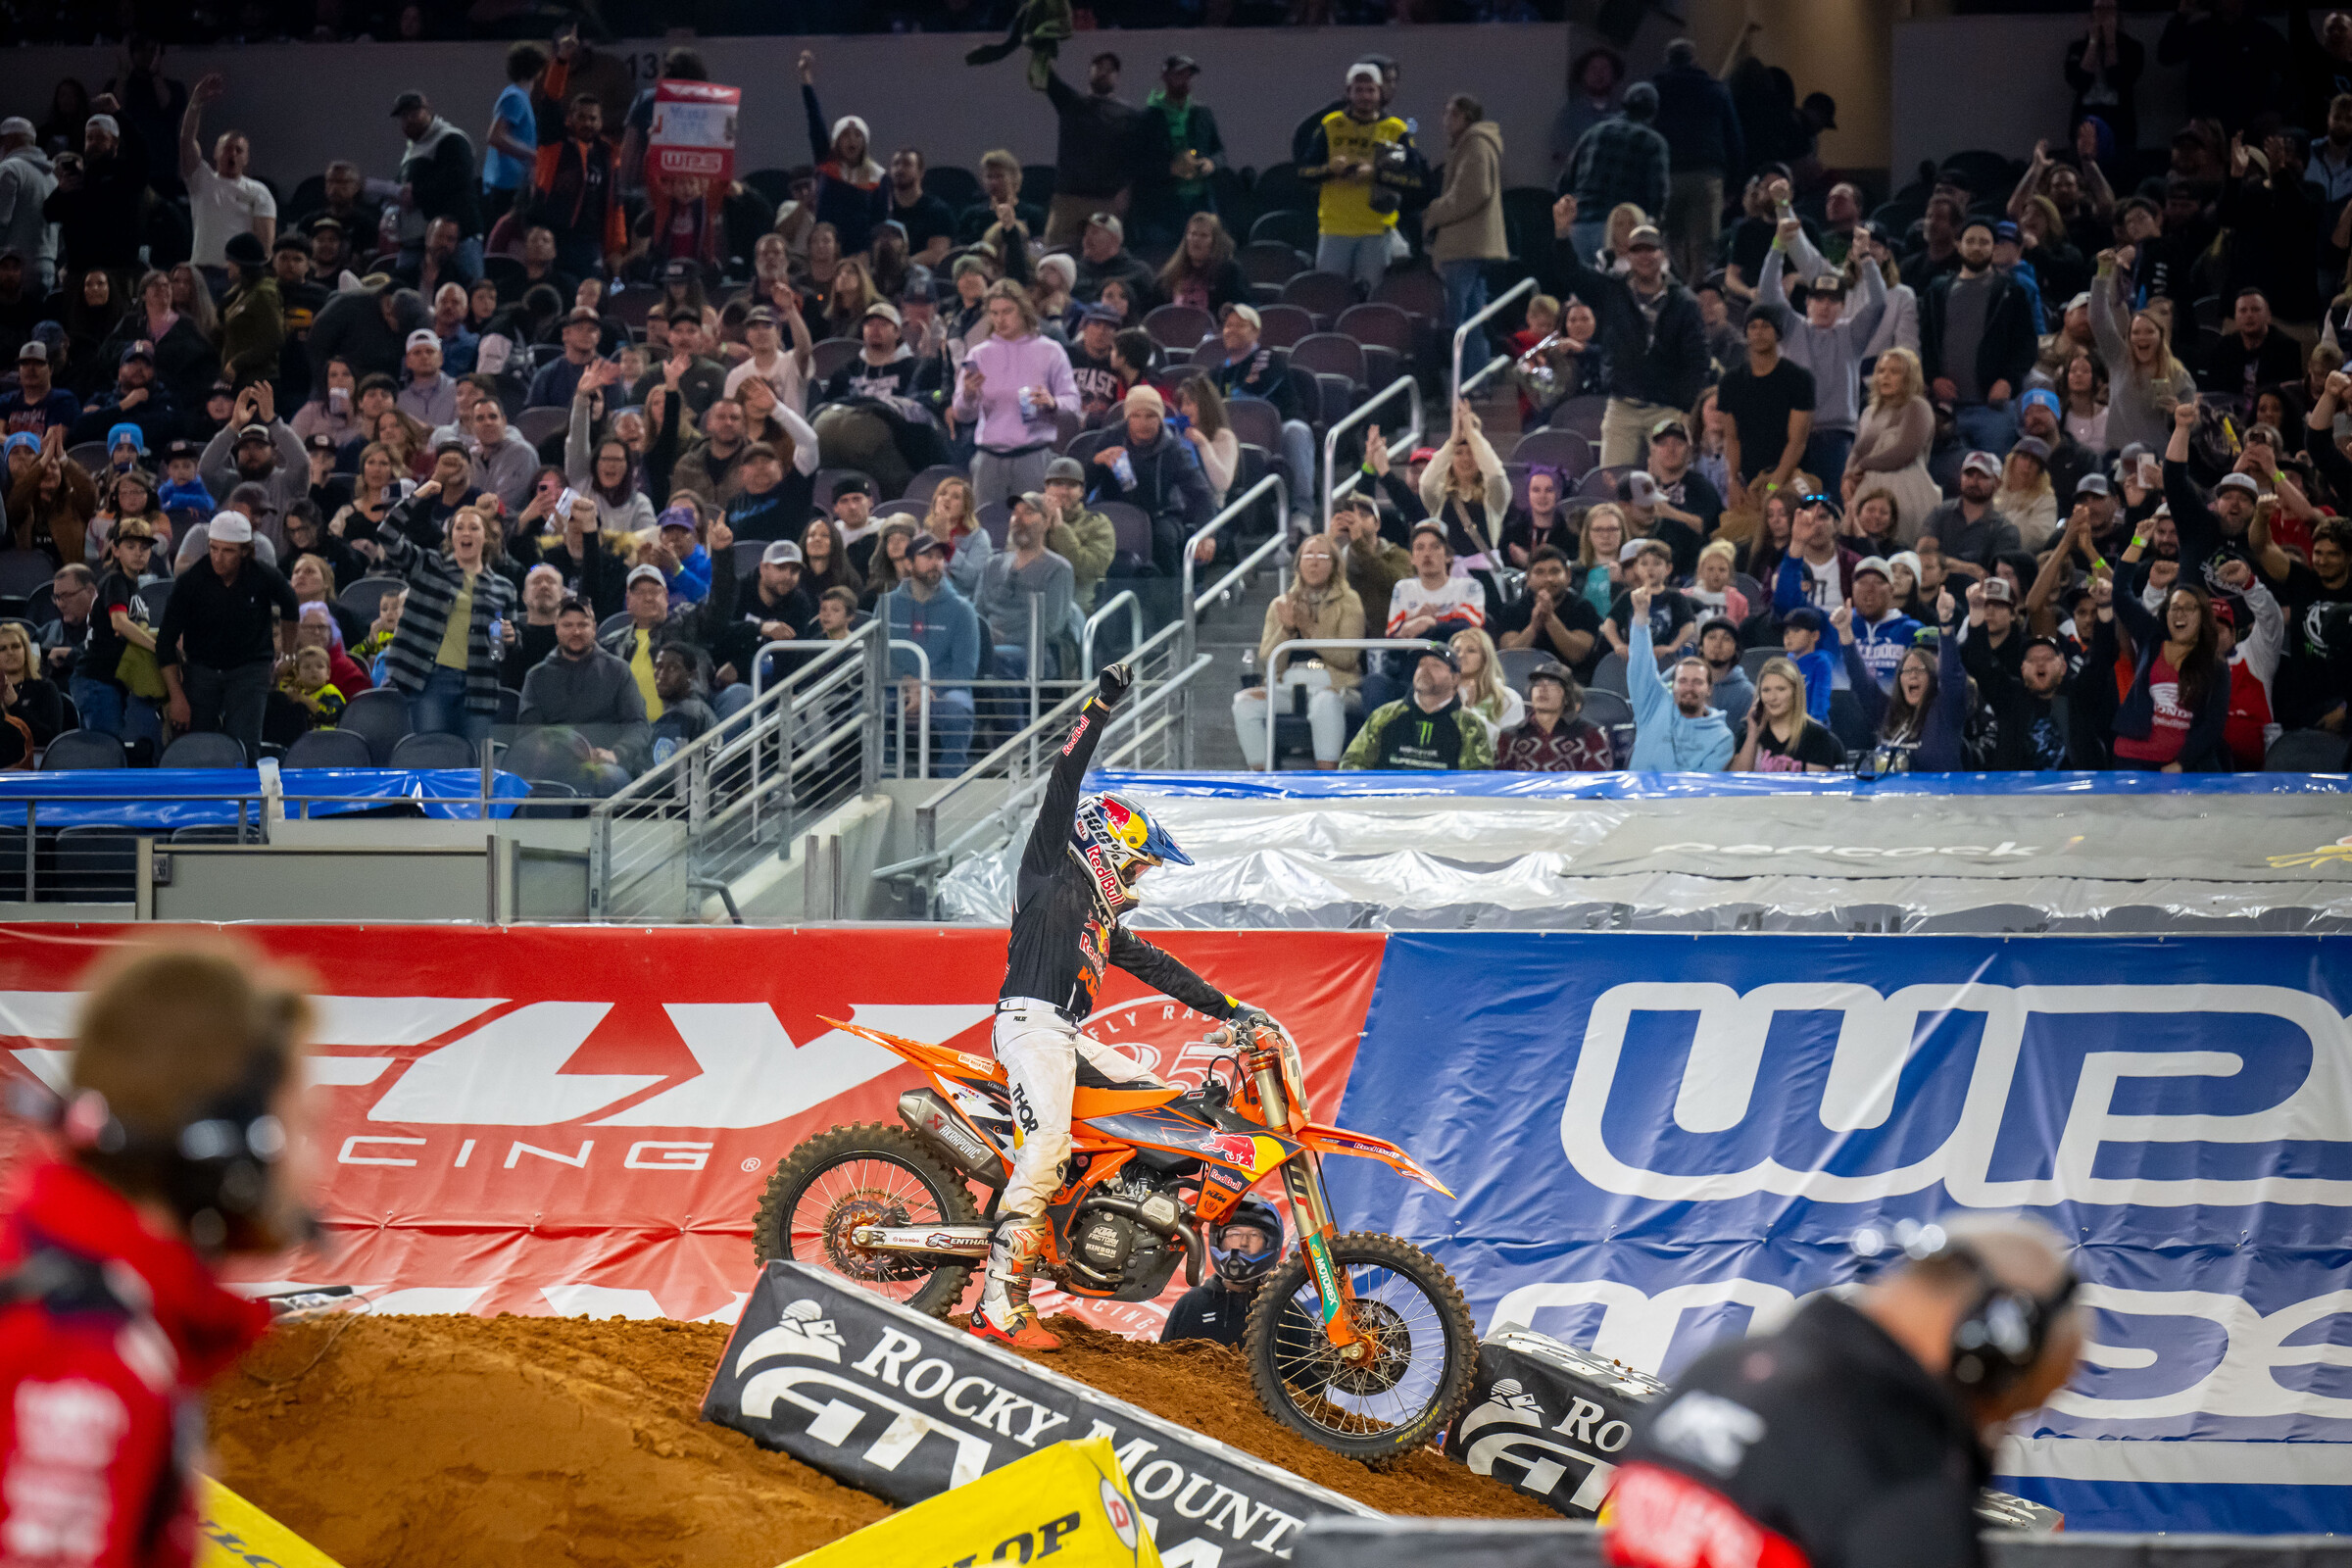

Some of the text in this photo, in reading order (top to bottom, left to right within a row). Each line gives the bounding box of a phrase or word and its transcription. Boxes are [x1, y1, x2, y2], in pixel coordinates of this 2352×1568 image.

[626, 52, 664, 78] 13
[1073, 368, 1118, 399] HASE
[1076, 820, 1088, 839] BELL
[1087, 1010, 1137, 1041] FLY
[1012, 1083, 1039, 1136] THOR
[1560, 982, 2352, 1207] WP
[338, 1135, 714, 1173] CING
[1204, 1189, 1227, 1203] KTM
[1088, 1233, 1119, 1246] FACTORY
[1093, 1227, 1117, 1239] KTM
[1315, 1256, 1340, 1307] MOTOREX
[1395, 1405, 1441, 1444] DUNLOP
[852, 1326, 1069, 1447] ROCKY
[1086, 1417, 1307, 1560] MOUNT
[1108, 1499, 1129, 1529] D
